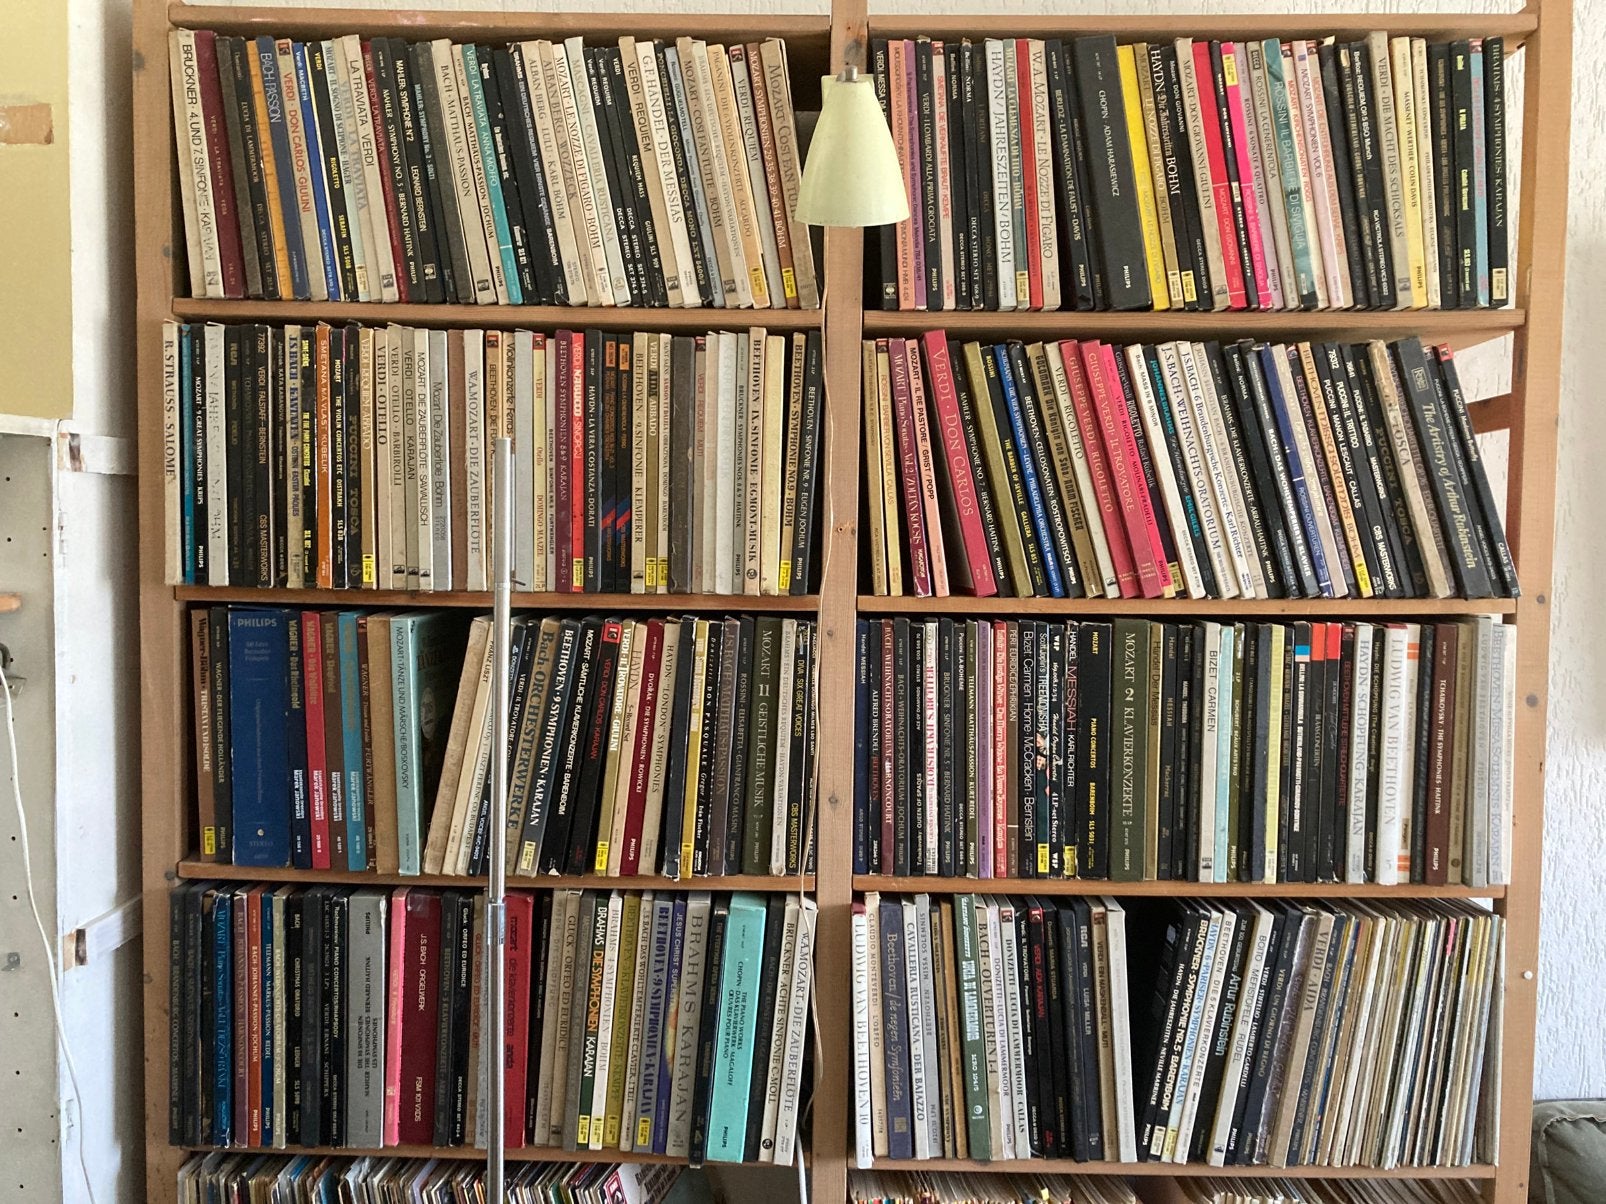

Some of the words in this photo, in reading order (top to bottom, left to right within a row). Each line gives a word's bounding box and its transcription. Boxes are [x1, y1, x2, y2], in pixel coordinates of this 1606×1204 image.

[351, 60, 361, 73] LA
[555, 57, 571, 100] MOZART
[1378, 58, 1389, 88] VERDI
[1493, 44, 1501, 92] BRAHMS
[284, 73, 295, 101] VERDI
[353, 75, 368, 126] TRAVIATA
[384, 89, 394, 117] MAHLER
[1099, 90, 1109, 119] CHOPIN
[1275, 82, 1289, 124] ROSSINI
[1382, 97, 1391, 113] DIE
[289, 110, 300, 133] DON
[565, 106, 574, 118] LE
[738, 79, 749, 108] VERDI
[744, 116, 758, 161] REQUIEM
[361, 135, 374, 167] VERDI
[389, 124, 400, 163] SYMPHONY
[567, 121, 582, 157] NOZZE
[1103, 125, 1113, 146] ADAM
[1281, 129, 1290, 137] IL
[1384, 116, 1395, 153] MACHT
[1494, 104, 1502, 173] SYMPHONIES
[292, 135, 305, 172] CARLOS
[575, 161, 584, 170] DI
[658, 141, 671, 166] DER
[1107, 148, 1120, 196] HARASIEWICZ
[1282, 140, 1297, 191] BARBIERE
[1388, 156, 1398, 174] DES
[577, 173, 592, 211] FIGARO
[663, 170, 681, 223] MESSIAS
[923, 123, 931, 160] LOMBARDI
[927, 206, 935, 242] CROCIATA
[1289, 196, 1299, 204] DI
[398, 193, 409, 225] BERNARD
[1390, 178, 1404, 237] SCHICKSALS
[403, 228, 414, 256] HAITINK
[1122, 265, 1132, 288] PHILIPS
[165, 340, 174, 351] R.
[910, 348, 920, 380] MOZART
[1329, 350, 1340, 369] 79312
[405, 350, 413, 379] VERDI
[752, 340, 760, 402] BEETHOVEN
[932, 347, 952, 400] VERDI
[1088, 353, 1107, 400] GIUSEPPE
[165, 355, 175, 412] STRAUSS
[649, 370, 658, 397] AIDA
[916, 397, 923, 406] RE
[405, 389, 414, 425] OTELLO
[917, 407, 927, 443] PASTORE
[1100, 402, 1115, 433] VERDI
[1422, 403, 1438, 423] The
[166, 424, 175, 476] SALOME
[751, 426, 759, 474] SINFONIE
[945, 414, 962, 450] DON
[1109, 438, 1118, 448] IL
[1346, 419, 1360, 448] TRITTICO
[1425, 425, 1450, 464] Artistry
[407, 436, 415, 480] KARAJAN
[923, 450, 931, 472] GRIST
[1437, 467, 1453, 476] of
[926, 479, 935, 499] POPP
[953, 456, 974, 516] CARLOS
[1112, 450, 1134, 512] TROVATORE
[1442, 478, 1463, 513] Arthur
[749, 482, 757, 561] EGMONT-MUSIK
[1374, 526, 1384, 539] CBS
[1452, 514, 1477, 568] Rubinstein
[1378, 543, 1397, 590] MASTERWORKS
[237, 619, 277, 627] PHILIPS
[537, 632, 554, 665] Bach
[554, 630, 574, 691] BEETHOVEN
[1024, 632, 1033, 656] Bizet:
[1125, 632, 1134, 682] MOZART
[1024, 659, 1033, 696] Carmen
[1209, 651, 1217, 678] BIZET
[1124, 688, 1134, 701] 2
[1208, 687, 1217, 732] CARMEN
[1024, 703, 1034, 732] Horne
[507, 671, 547, 829] ORCHESTERWERKE
[539, 704, 560, 773] SYMPHONIEN
[1025, 736, 1034, 791] McCracken
[1123, 707, 1133, 816] KLAVIERKONZERTE
[530, 779, 546, 825] KARAJAN
[1025, 797, 1034, 840] Bernstein
[790, 818, 798, 868] MASTERWORKS
[595, 907, 606, 945] BRAHMS
[593, 950, 603, 966] DIE
[684, 915, 703, 1013] BRAHMS
[781, 923, 794, 975] BRUCKNER
[907, 923, 917, 983] CAVALLERIA
[1312, 931, 1328, 971] VERDI
[588, 968, 602, 1031] SYMPHONIEN
[777, 981, 788, 1014] ACHTE
[1226, 973, 1241, 1000] Artur
[1304, 981, 1318, 1011] AIDA
[910, 987, 920, 1043] RUSTICANA
[1216, 1003, 1236, 1056] Rubinstein
[584, 1037, 596, 1077] KARAJAN
[772, 1017, 785, 1064] SINFONIE
[675, 1024, 694, 1123] KARAJAN
[913, 1054, 922, 1074] DER
[768, 1066, 780, 1104] C-MOLL
